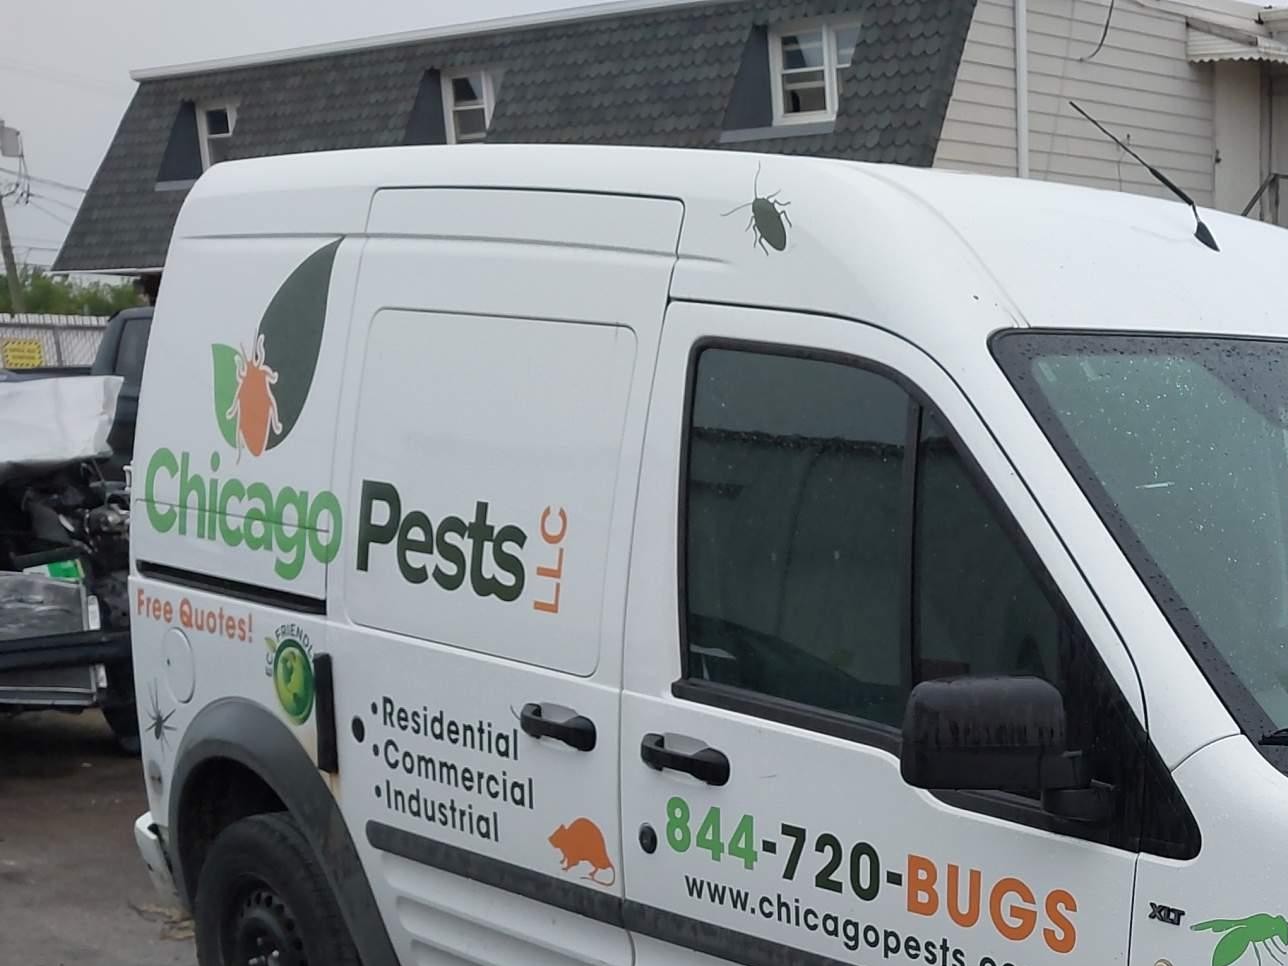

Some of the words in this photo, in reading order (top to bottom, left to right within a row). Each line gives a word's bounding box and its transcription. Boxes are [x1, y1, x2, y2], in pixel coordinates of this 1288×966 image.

[144, 447, 343, 581] Chicago
[356, 479, 527, 602] Pests
[533, 505, 568, 613] LLC
[137, 588, 173, 623] Free
[179, 598, 254, 643] Quotes!
[382, 696, 519, 760] Residential
[384, 739, 534, 809] Commercial
[386, 780, 499, 842] Industrial
[665, 796, 1078, 954] 844-720-BUGS
[1148, 902, 1186, 927] XLT
